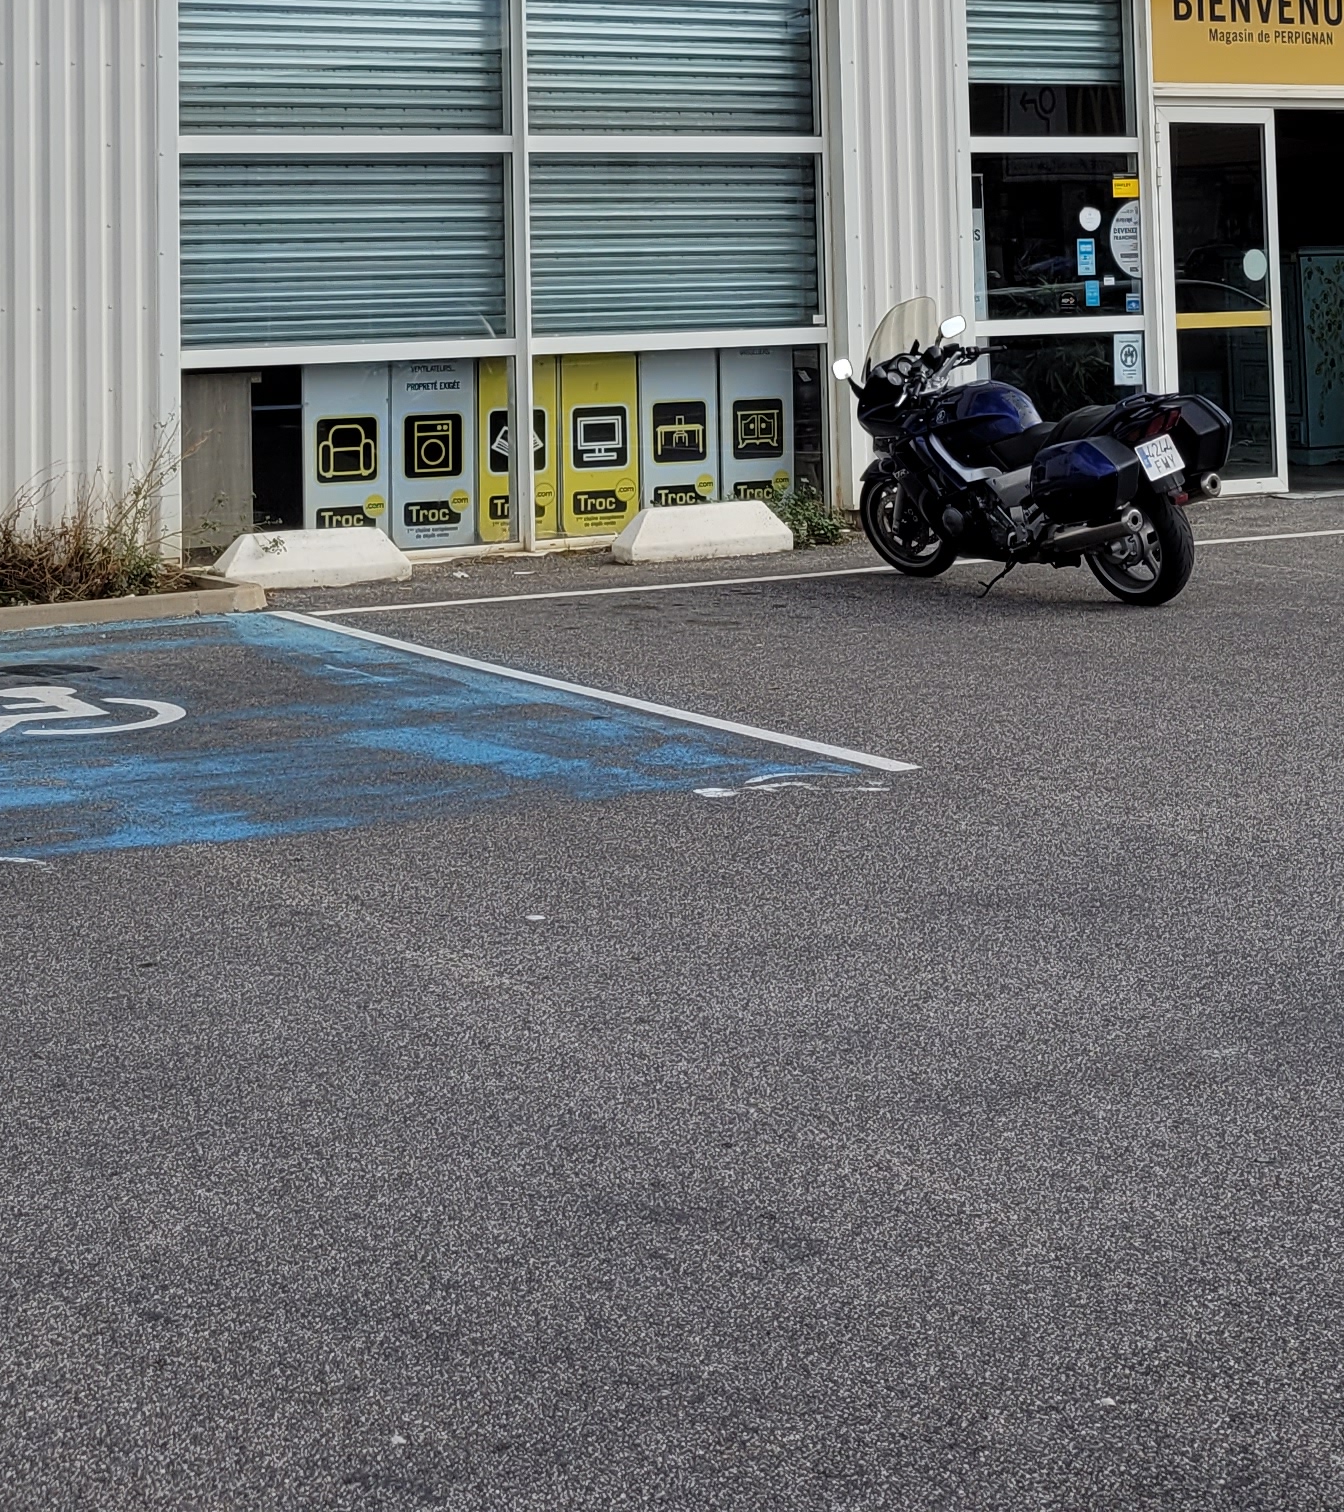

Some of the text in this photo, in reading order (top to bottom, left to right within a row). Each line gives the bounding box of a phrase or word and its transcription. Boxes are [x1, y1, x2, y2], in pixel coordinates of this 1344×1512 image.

[1209, 28, 1334, 45] Magasin de PERPIGNAN
[406, 380, 438, 391] PROPRETÉ
[577, 494, 616, 512] Troc
[658, 490, 696, 506] Troc
[408, 506, 450, 522] Troc
[494, 499, 510, 516] Tr
[320, 511, 364, 528] Troc
